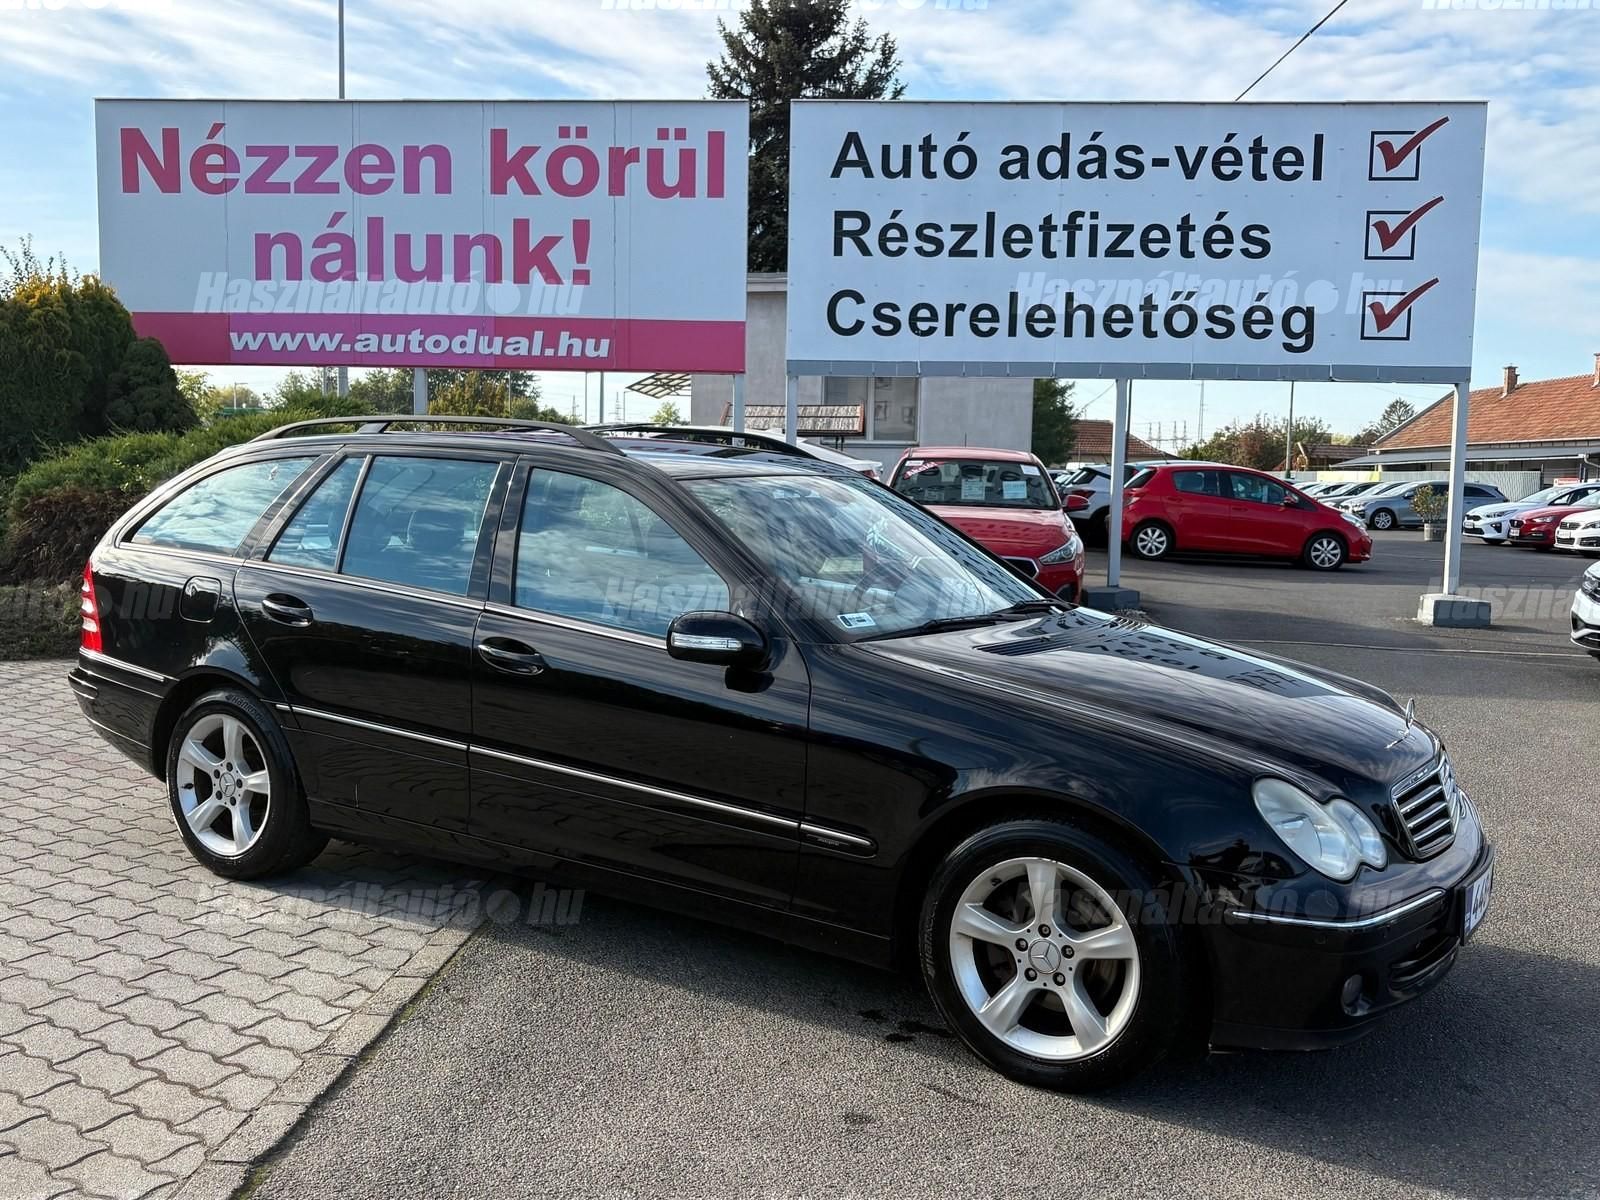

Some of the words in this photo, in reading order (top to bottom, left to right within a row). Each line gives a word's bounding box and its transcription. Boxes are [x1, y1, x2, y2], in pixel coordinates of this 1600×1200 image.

[120, 123, 452, 195] Nézzen
[490, 126, 725, 199] körül
[831, 131, 978, 181] Autó
[1000, 131, 1324, 183] adás-vétel
[254, 212, 591, 286] nálunk!
[833, 210, 1271, 259] Részletfizetés
[230, 328, 610, 359] www.autodual.hu
[827, 290, 1316, 352] Cserelehetőség
